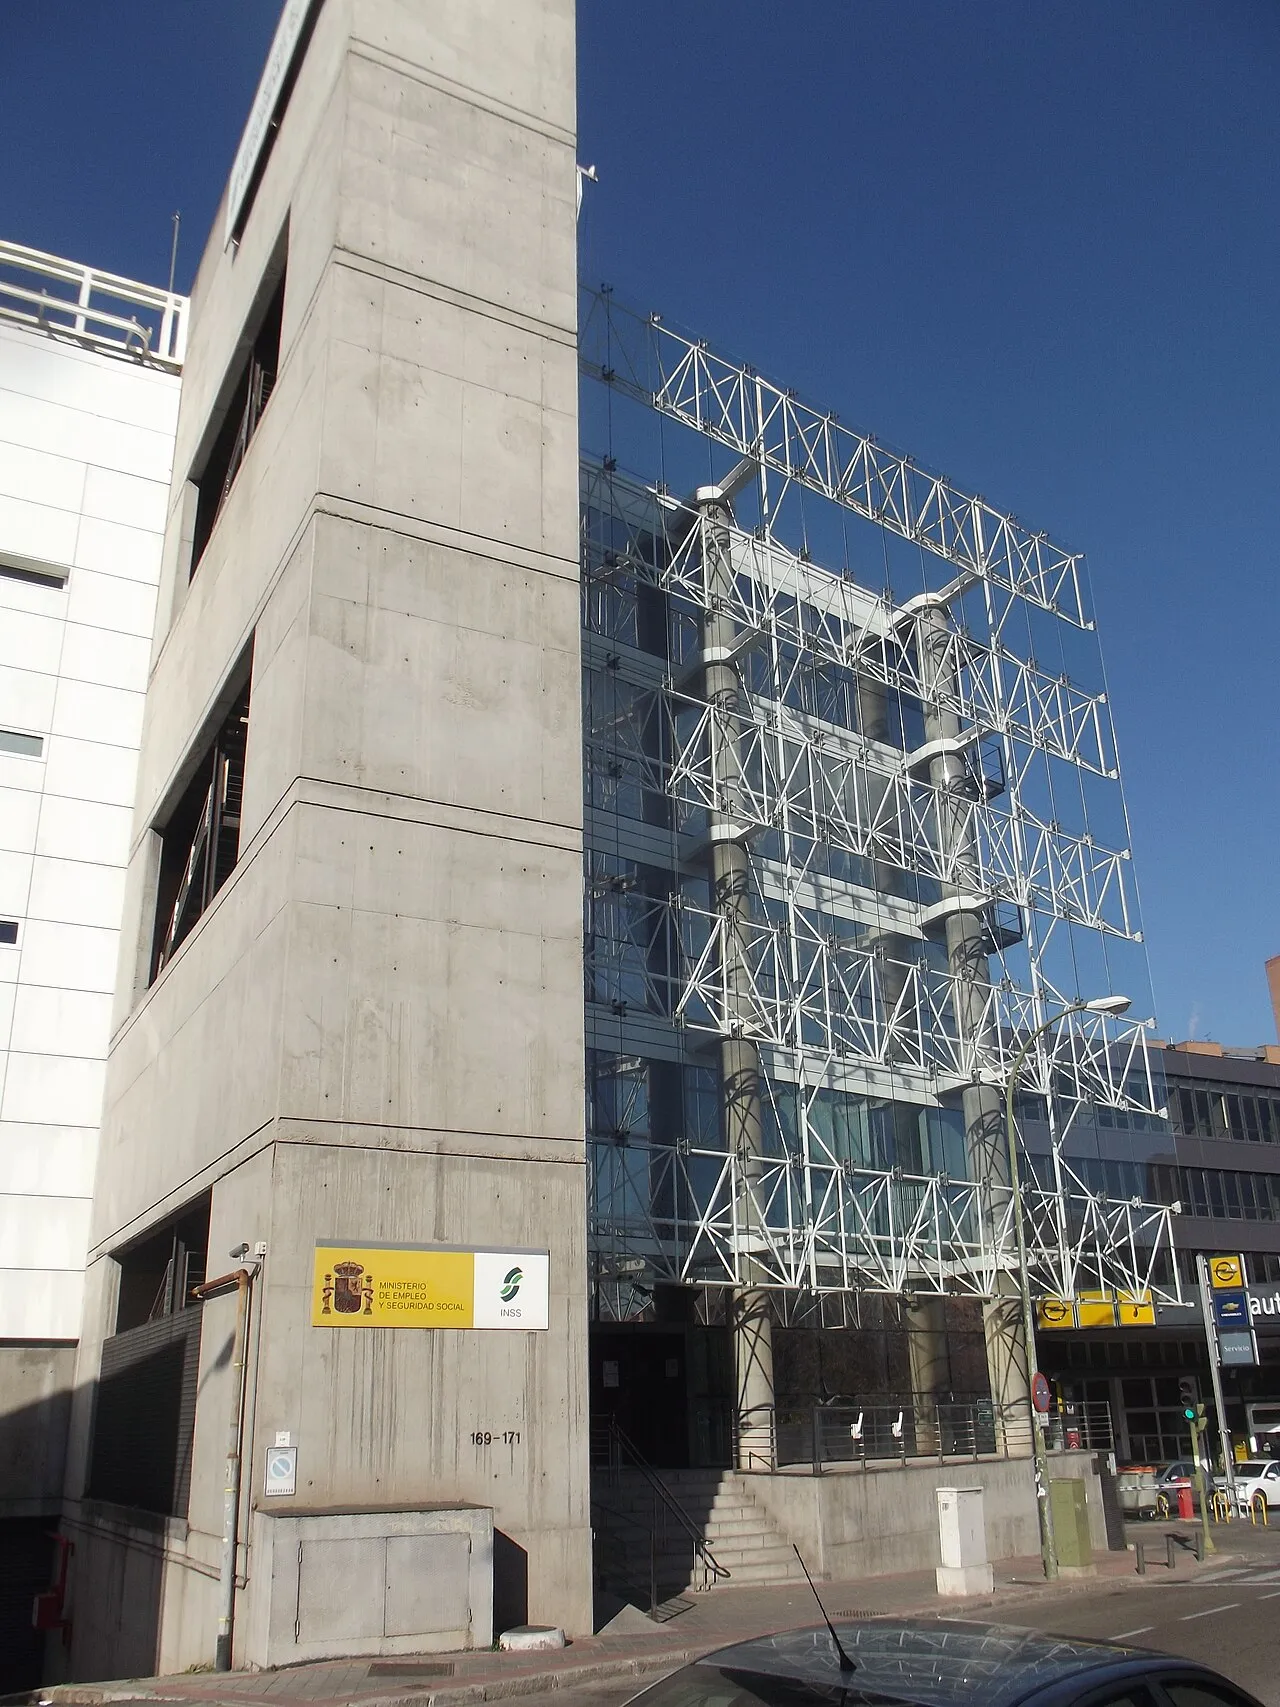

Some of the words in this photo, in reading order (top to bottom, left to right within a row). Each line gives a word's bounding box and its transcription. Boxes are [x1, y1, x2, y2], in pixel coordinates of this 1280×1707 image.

[379, 1282, 427, 1291] MINISTERIO
[393, 1292, 427, 1300] EMPLEO
[386, 1302, 435, 1311] SEGURIDAD
[436, 1303, 465, 1311] SOCIAL
[500, 1308, 522, 1317] INSS
[470, 1431, 521, 1445] 169-171
